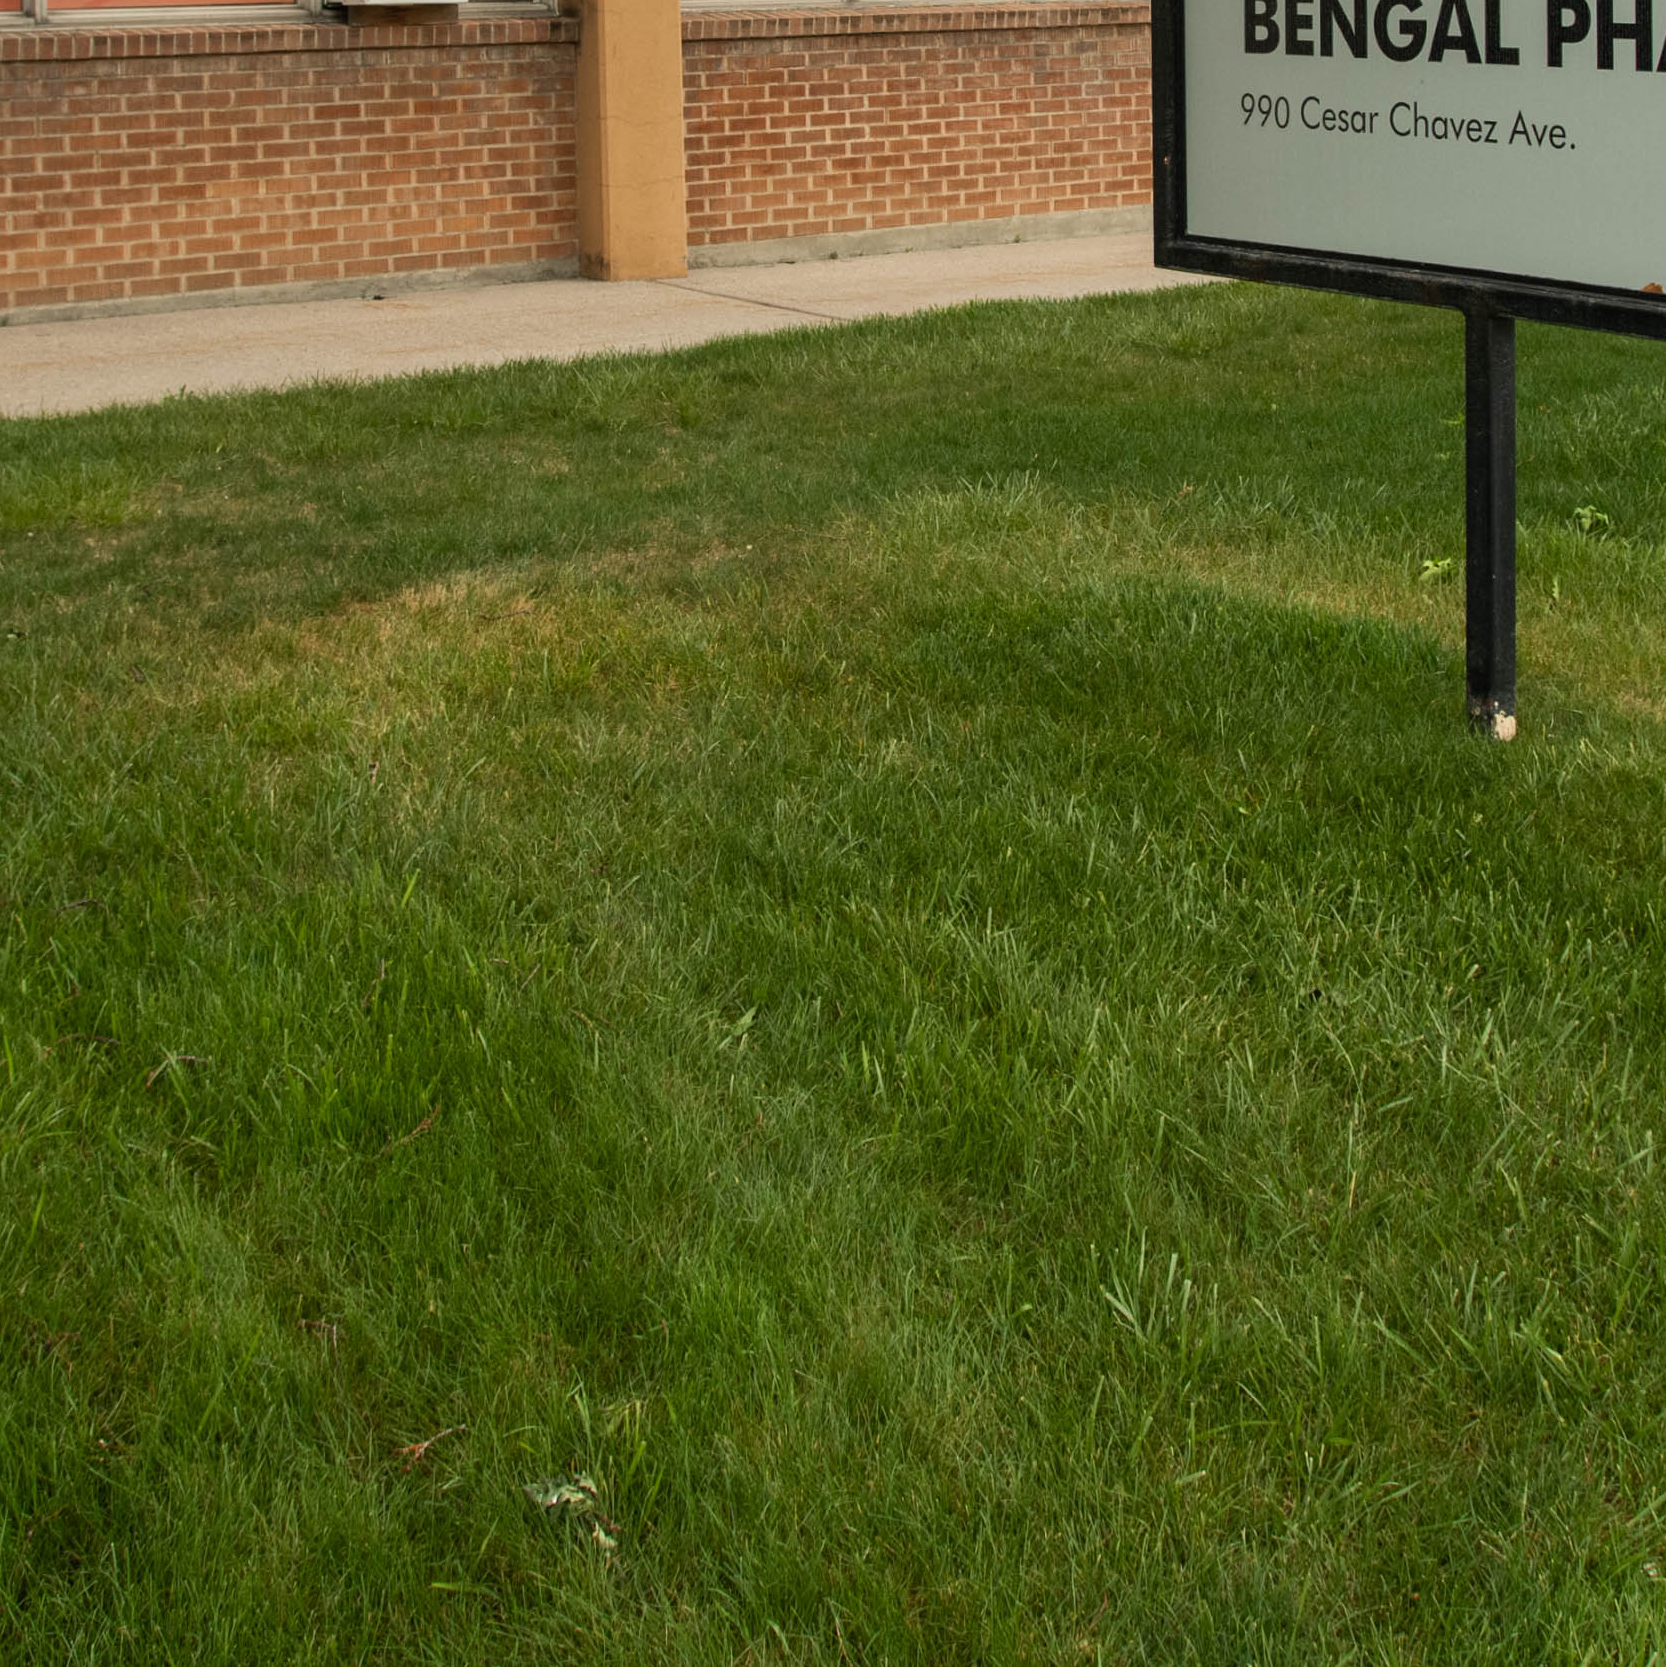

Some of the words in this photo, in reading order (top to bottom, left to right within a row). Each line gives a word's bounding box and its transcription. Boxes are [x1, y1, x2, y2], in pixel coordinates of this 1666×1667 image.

[1240, 93, 1290, 129] 990
[1300, 96, 1379, 134] Cesar
[1389, 102, 1498, 144] Chavez
[1509, 110, 1576, 150] Ave.
